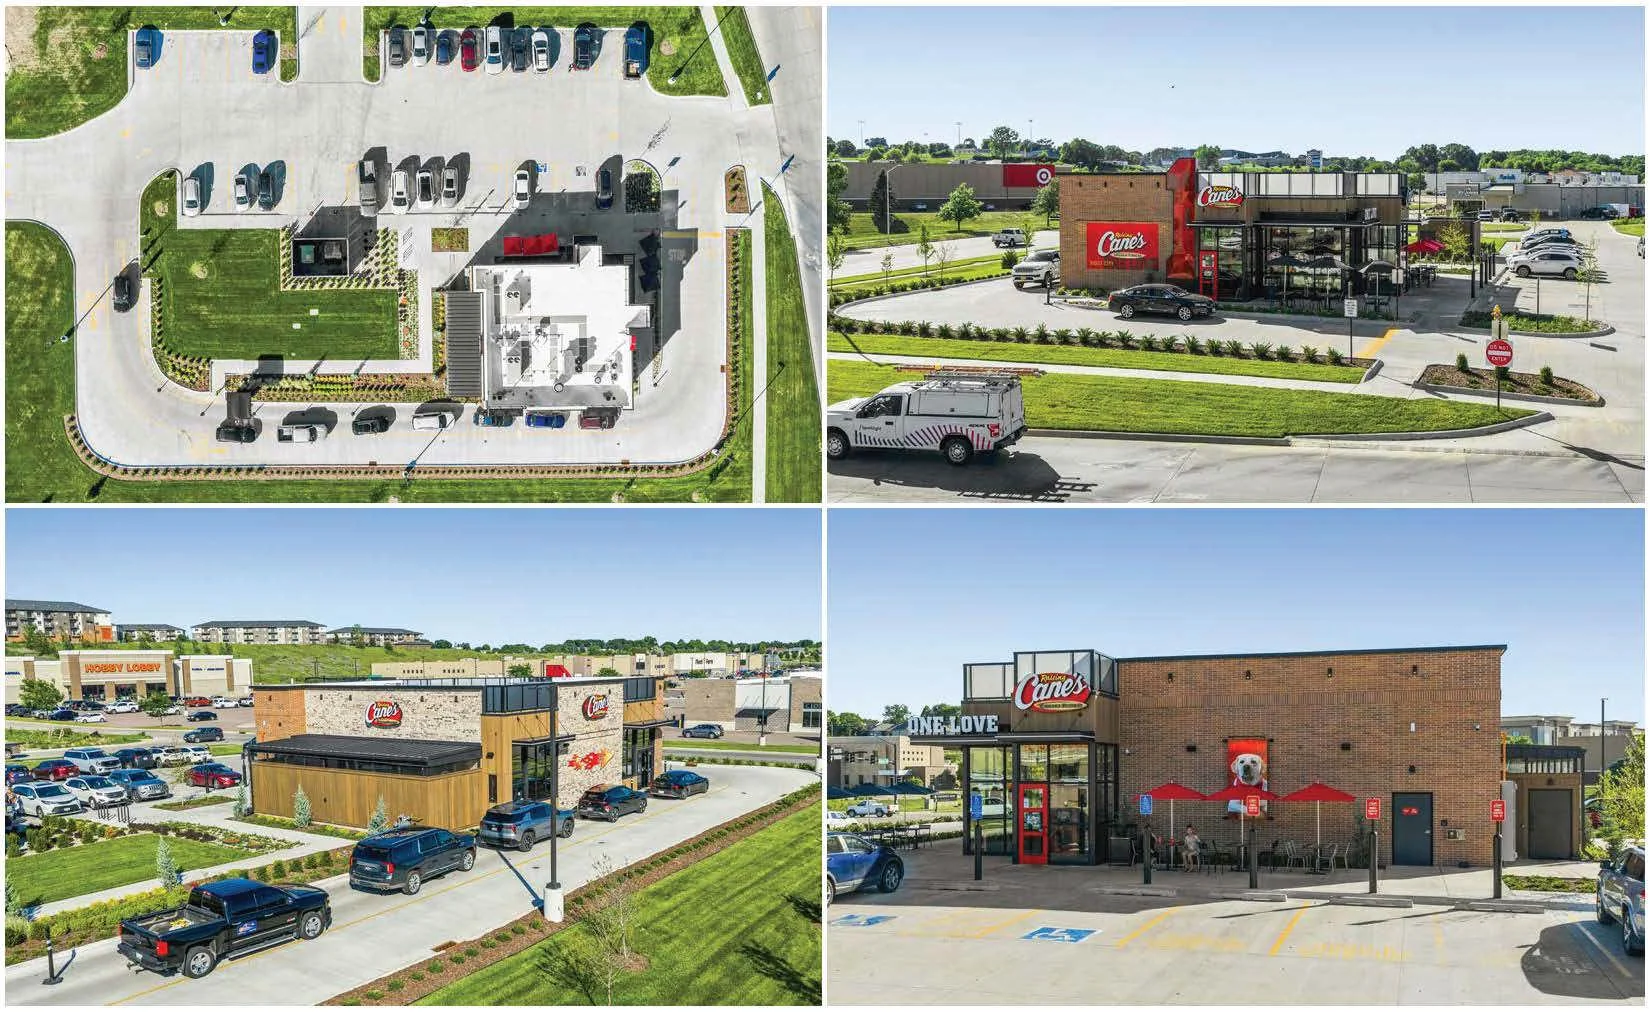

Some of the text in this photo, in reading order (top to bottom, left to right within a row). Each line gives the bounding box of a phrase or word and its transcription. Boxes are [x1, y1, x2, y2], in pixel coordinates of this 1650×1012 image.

[1197, 185, 1241, 207] Cane's
[1097, 231, 1147, 257] Cane's
[85, 663, 161, 673] HOBBY LOBBY
[1015, 672, 1088, 710] Cane's
[365, 701, 400, 723] Cane's
[908, 714, 999, 736] ONE LOVE
